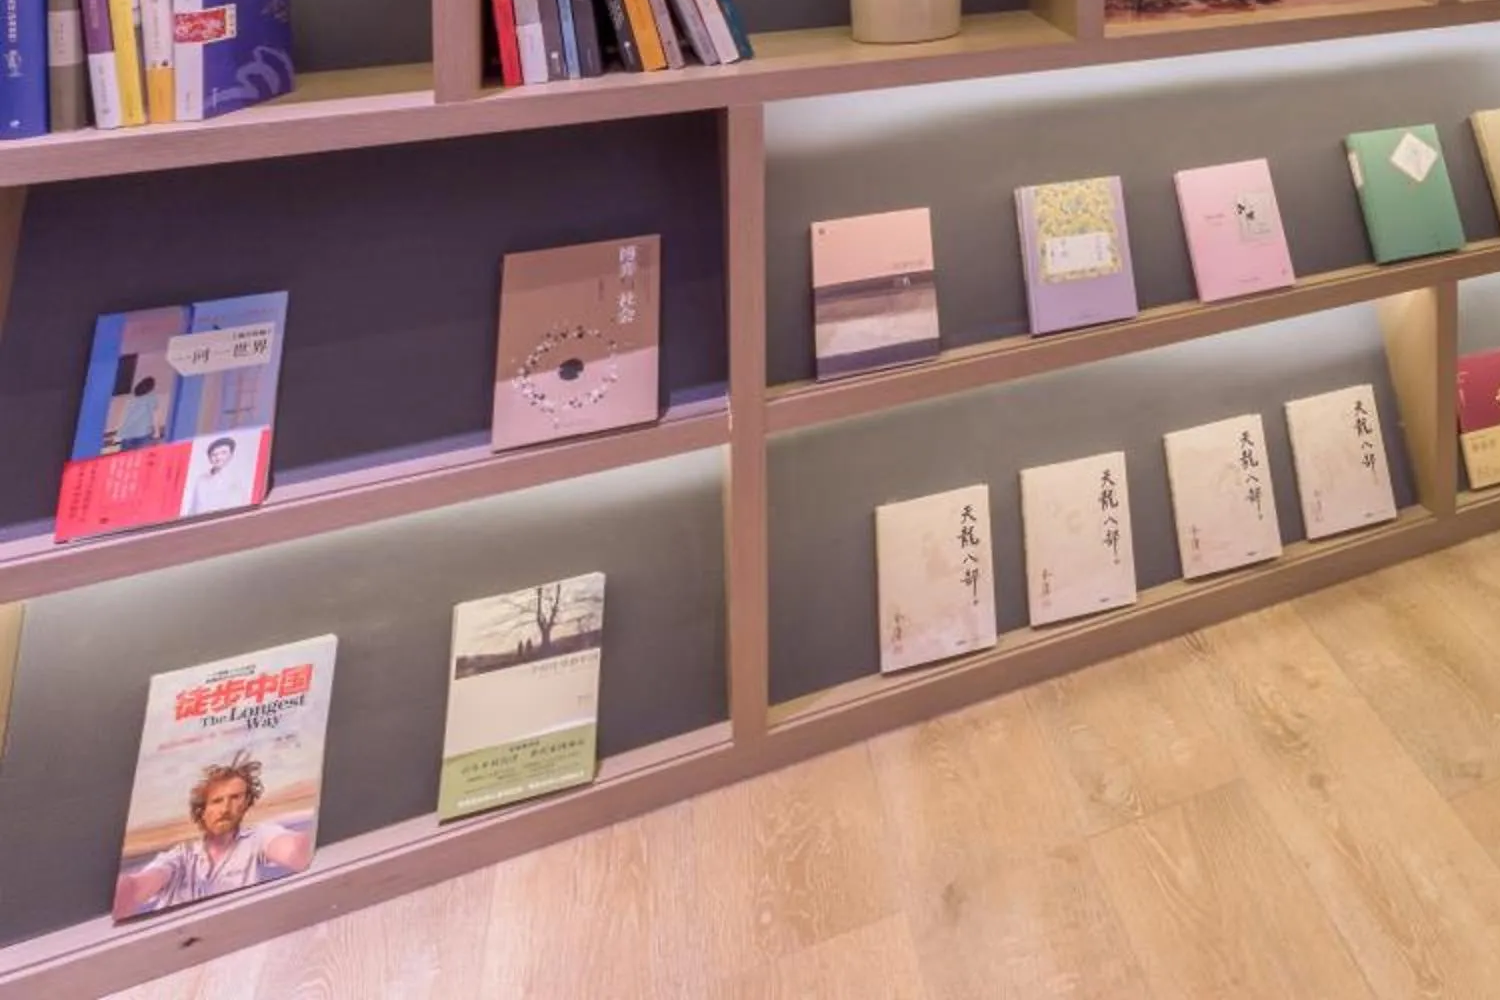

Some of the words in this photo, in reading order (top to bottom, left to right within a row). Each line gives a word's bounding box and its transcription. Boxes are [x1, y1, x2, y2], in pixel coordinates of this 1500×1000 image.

[175, 663, 314, 721] 徒步中国
[229, 694, 305, 721] Longest
